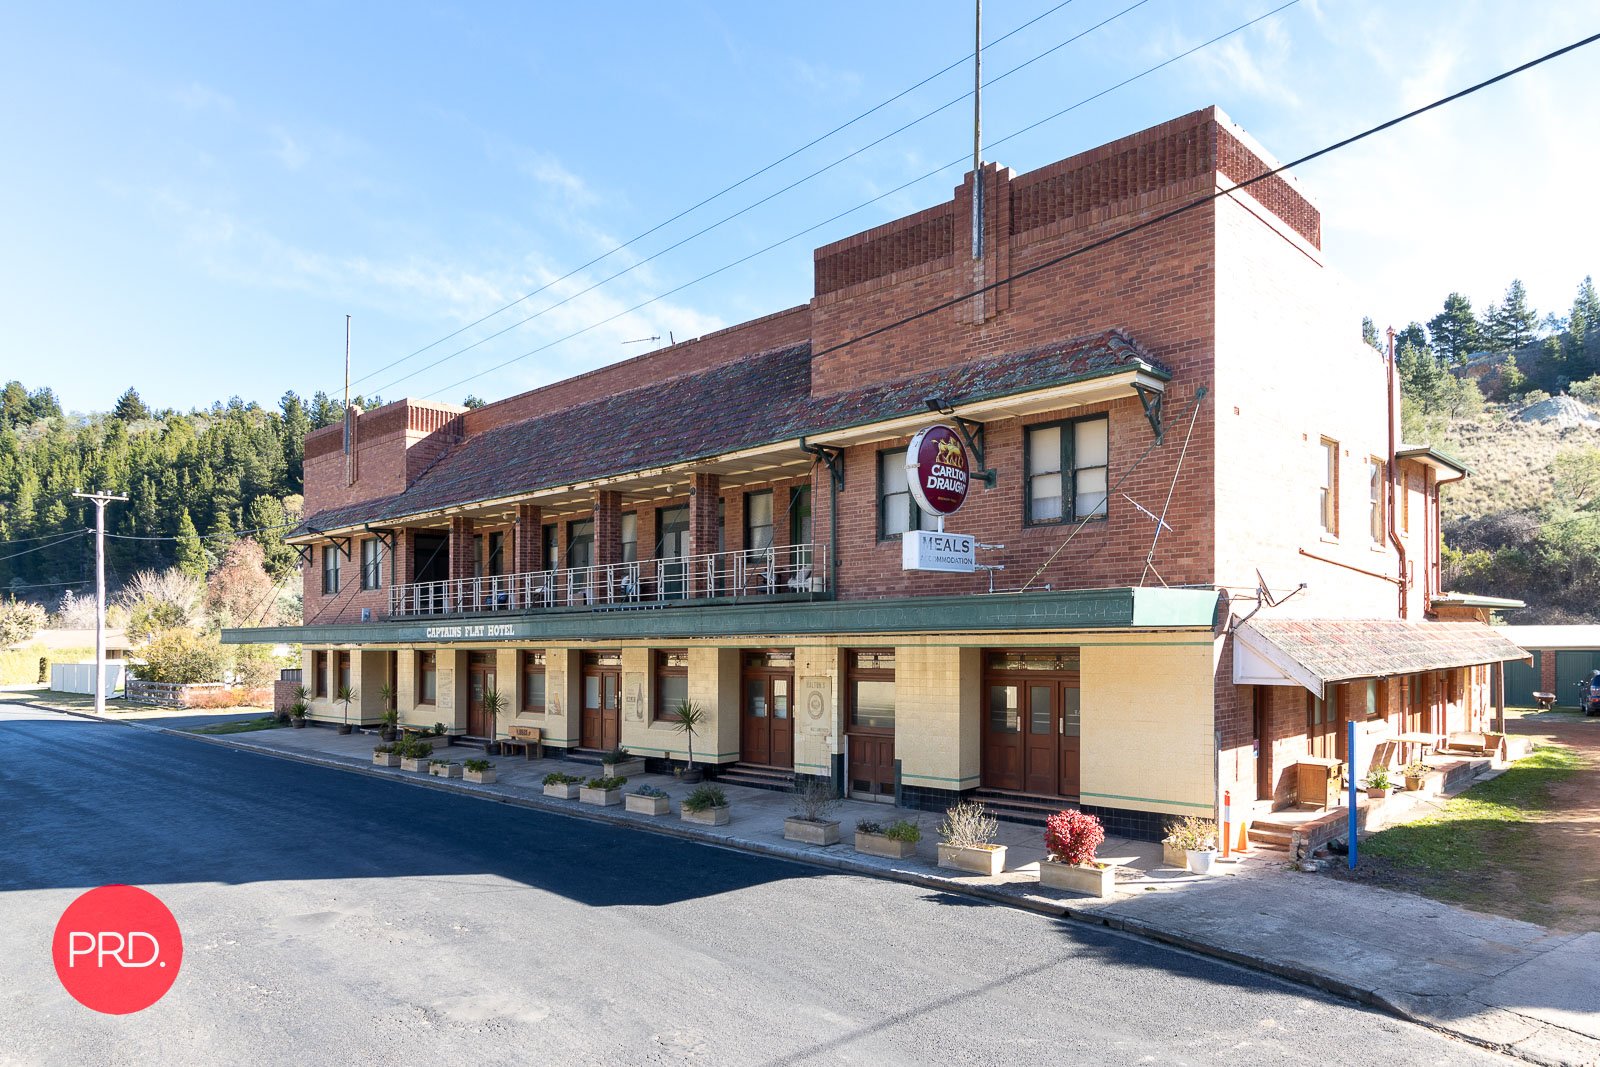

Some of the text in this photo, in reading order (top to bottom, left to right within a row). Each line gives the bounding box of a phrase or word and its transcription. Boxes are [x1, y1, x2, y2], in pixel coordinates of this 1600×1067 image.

[932, 464, 967, 482] CARLTON
[926, 476, 967, 493] DRAUGHT
[427, 624, 515, 638] CAPTAINS FLAT HOTEL
